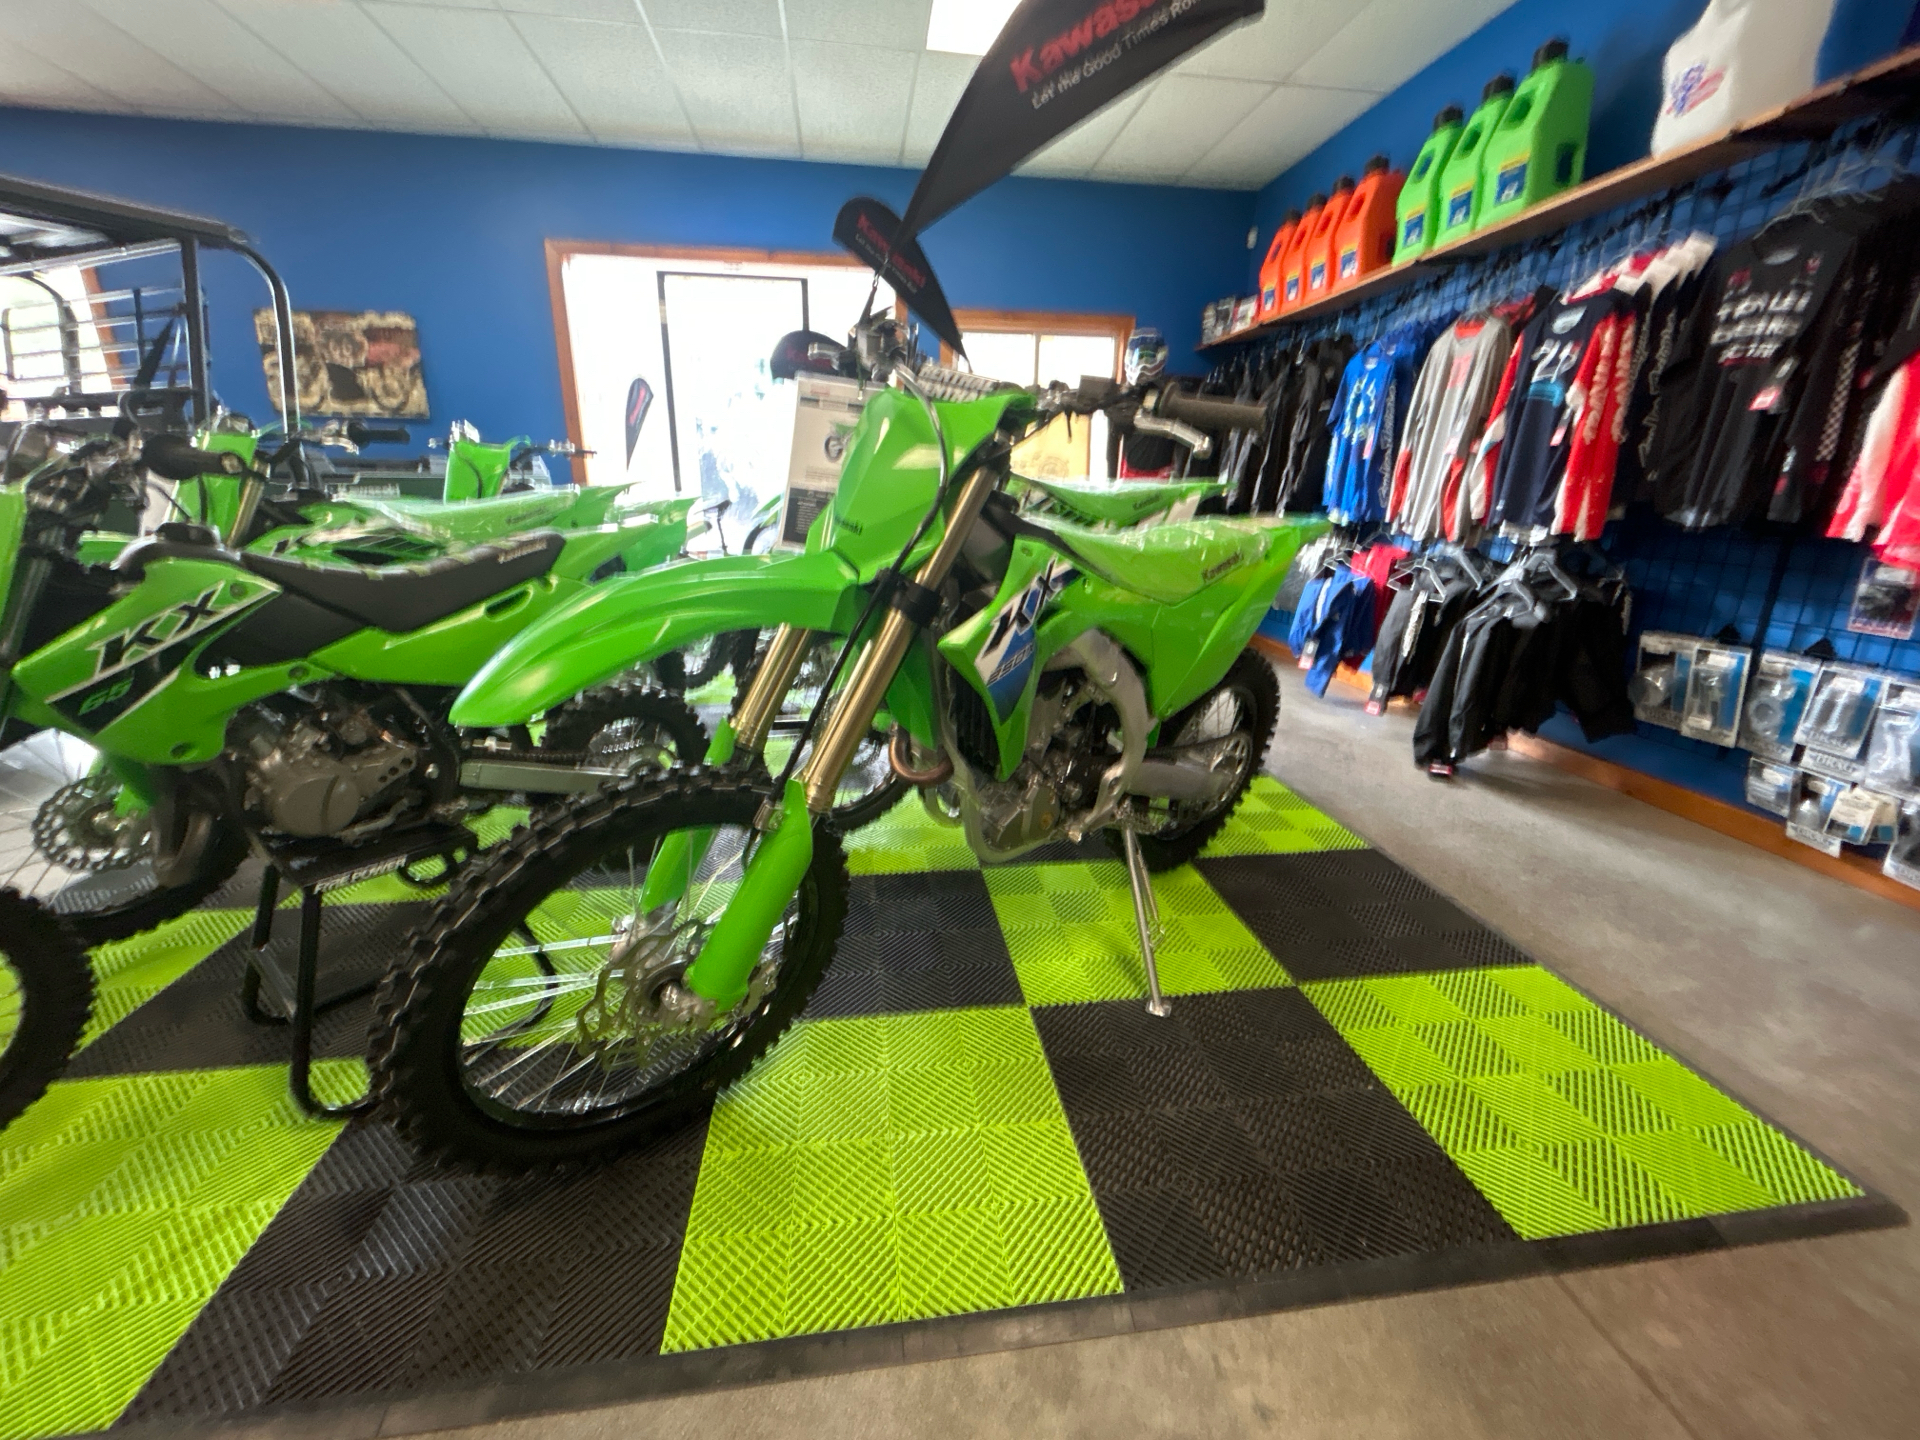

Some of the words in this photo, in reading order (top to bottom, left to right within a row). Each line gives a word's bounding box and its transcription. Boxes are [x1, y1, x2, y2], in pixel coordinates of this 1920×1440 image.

[1010, 0, 1156, 93] Kawas
[1031, 79, 1056, 109] Let
[1057, 69, 1082, 93] the
[1082, 41, 1123, 78] Good
[1122, 13, 1169, 49] Times
[1170, 0, 1197, 18] Ro
[86, 579, 225, 677] KX
[976, 553, 1063, 662] KX
[78, 675, 135, 716] 65
[350, 854, 408, 884] POWER
